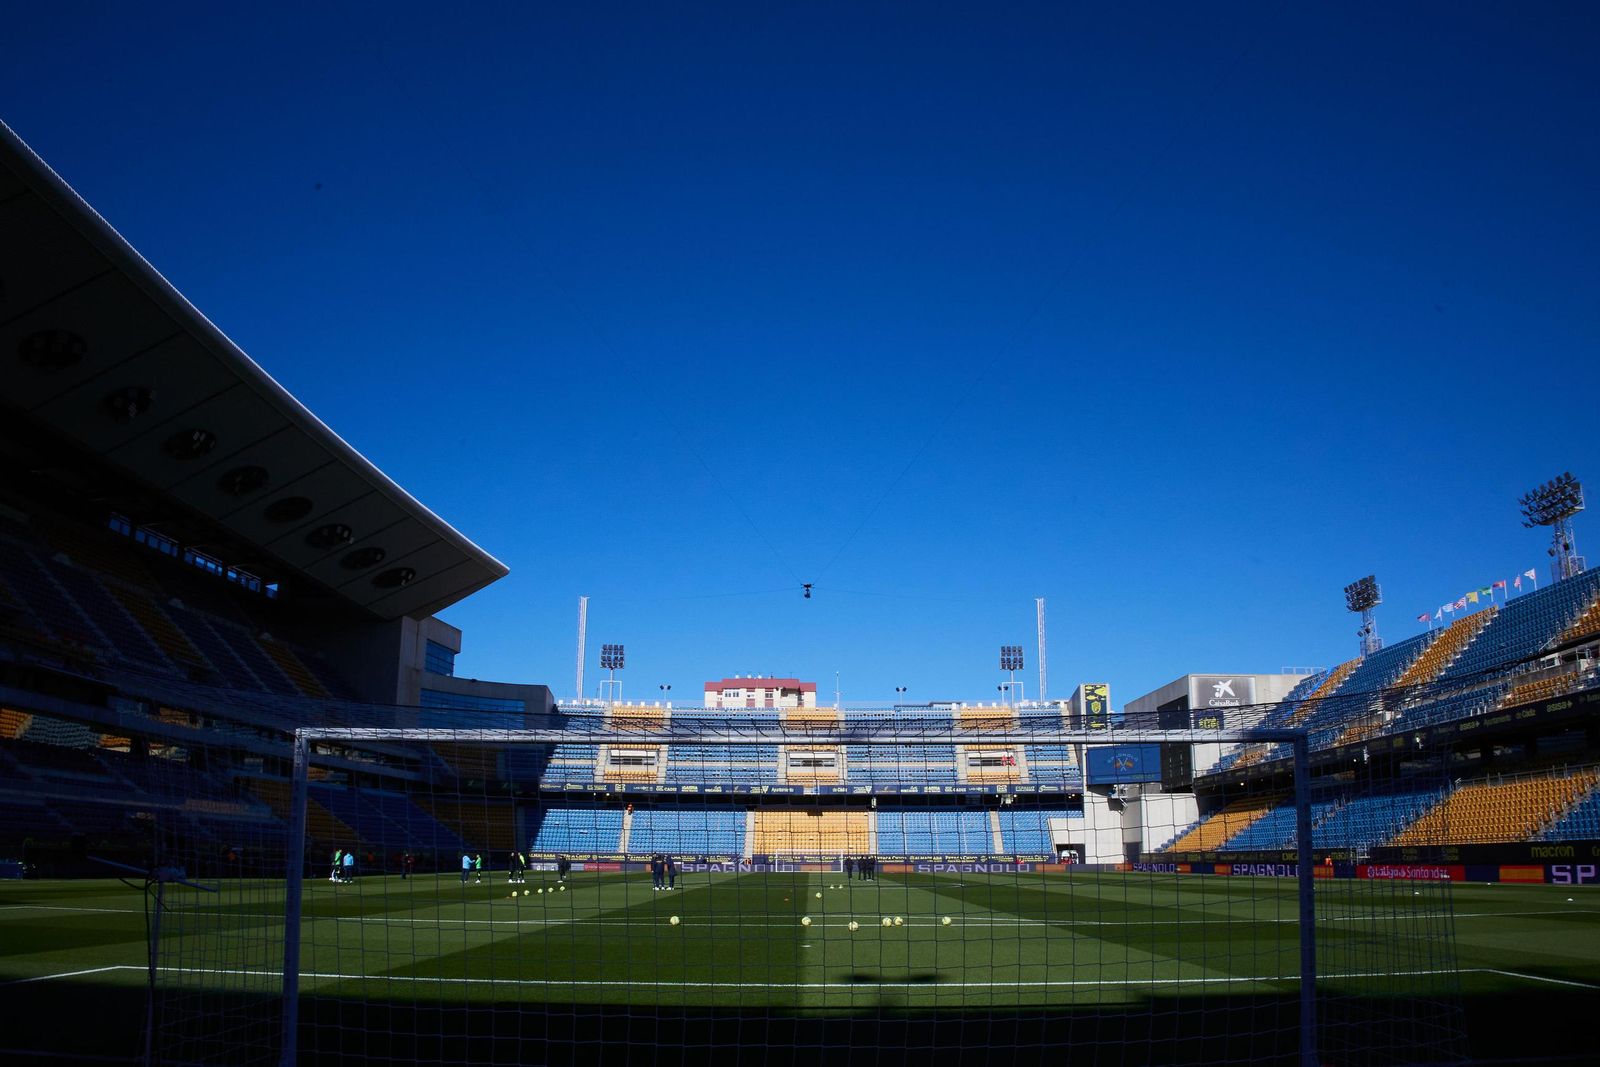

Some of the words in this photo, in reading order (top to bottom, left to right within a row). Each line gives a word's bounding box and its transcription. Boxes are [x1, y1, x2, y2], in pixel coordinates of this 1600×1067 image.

[1281, 852, 1298, 861] DIG
[1530, 845, 1575, 858] macron
[918, 864, 1030, 873] SPAGNOLO
[1133, 863, 1175, 873] SPAGNOLO
[1375, 866, 1399, 878] LaLiga
[1551, 864, 1596, 884] SP
